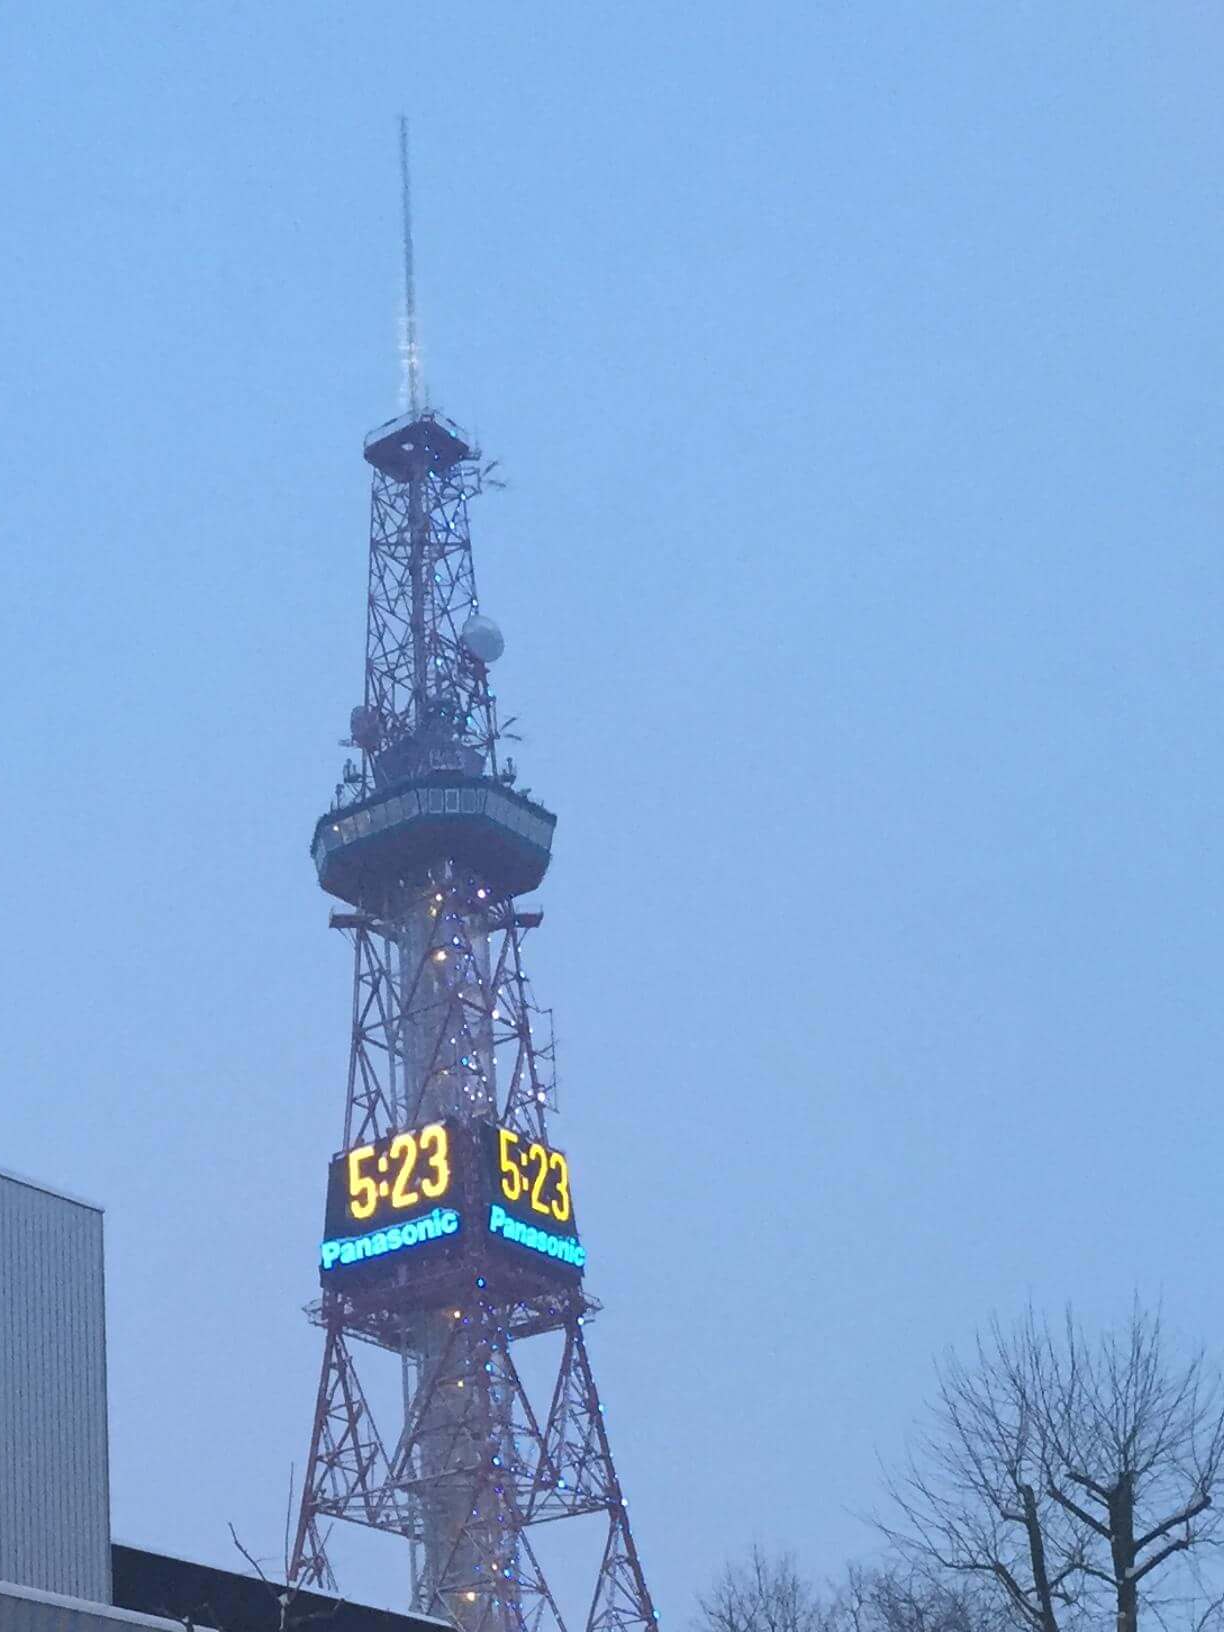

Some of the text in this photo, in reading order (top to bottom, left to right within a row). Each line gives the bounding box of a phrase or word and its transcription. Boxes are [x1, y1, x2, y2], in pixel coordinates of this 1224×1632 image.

[348, 1123, 449, 1219] 5:23
[499, 1128, 570, 1221] 5:23
[321, 1207, 459, 1269] Panasonic
[489, 1204, 587, 1267] Panasonic
